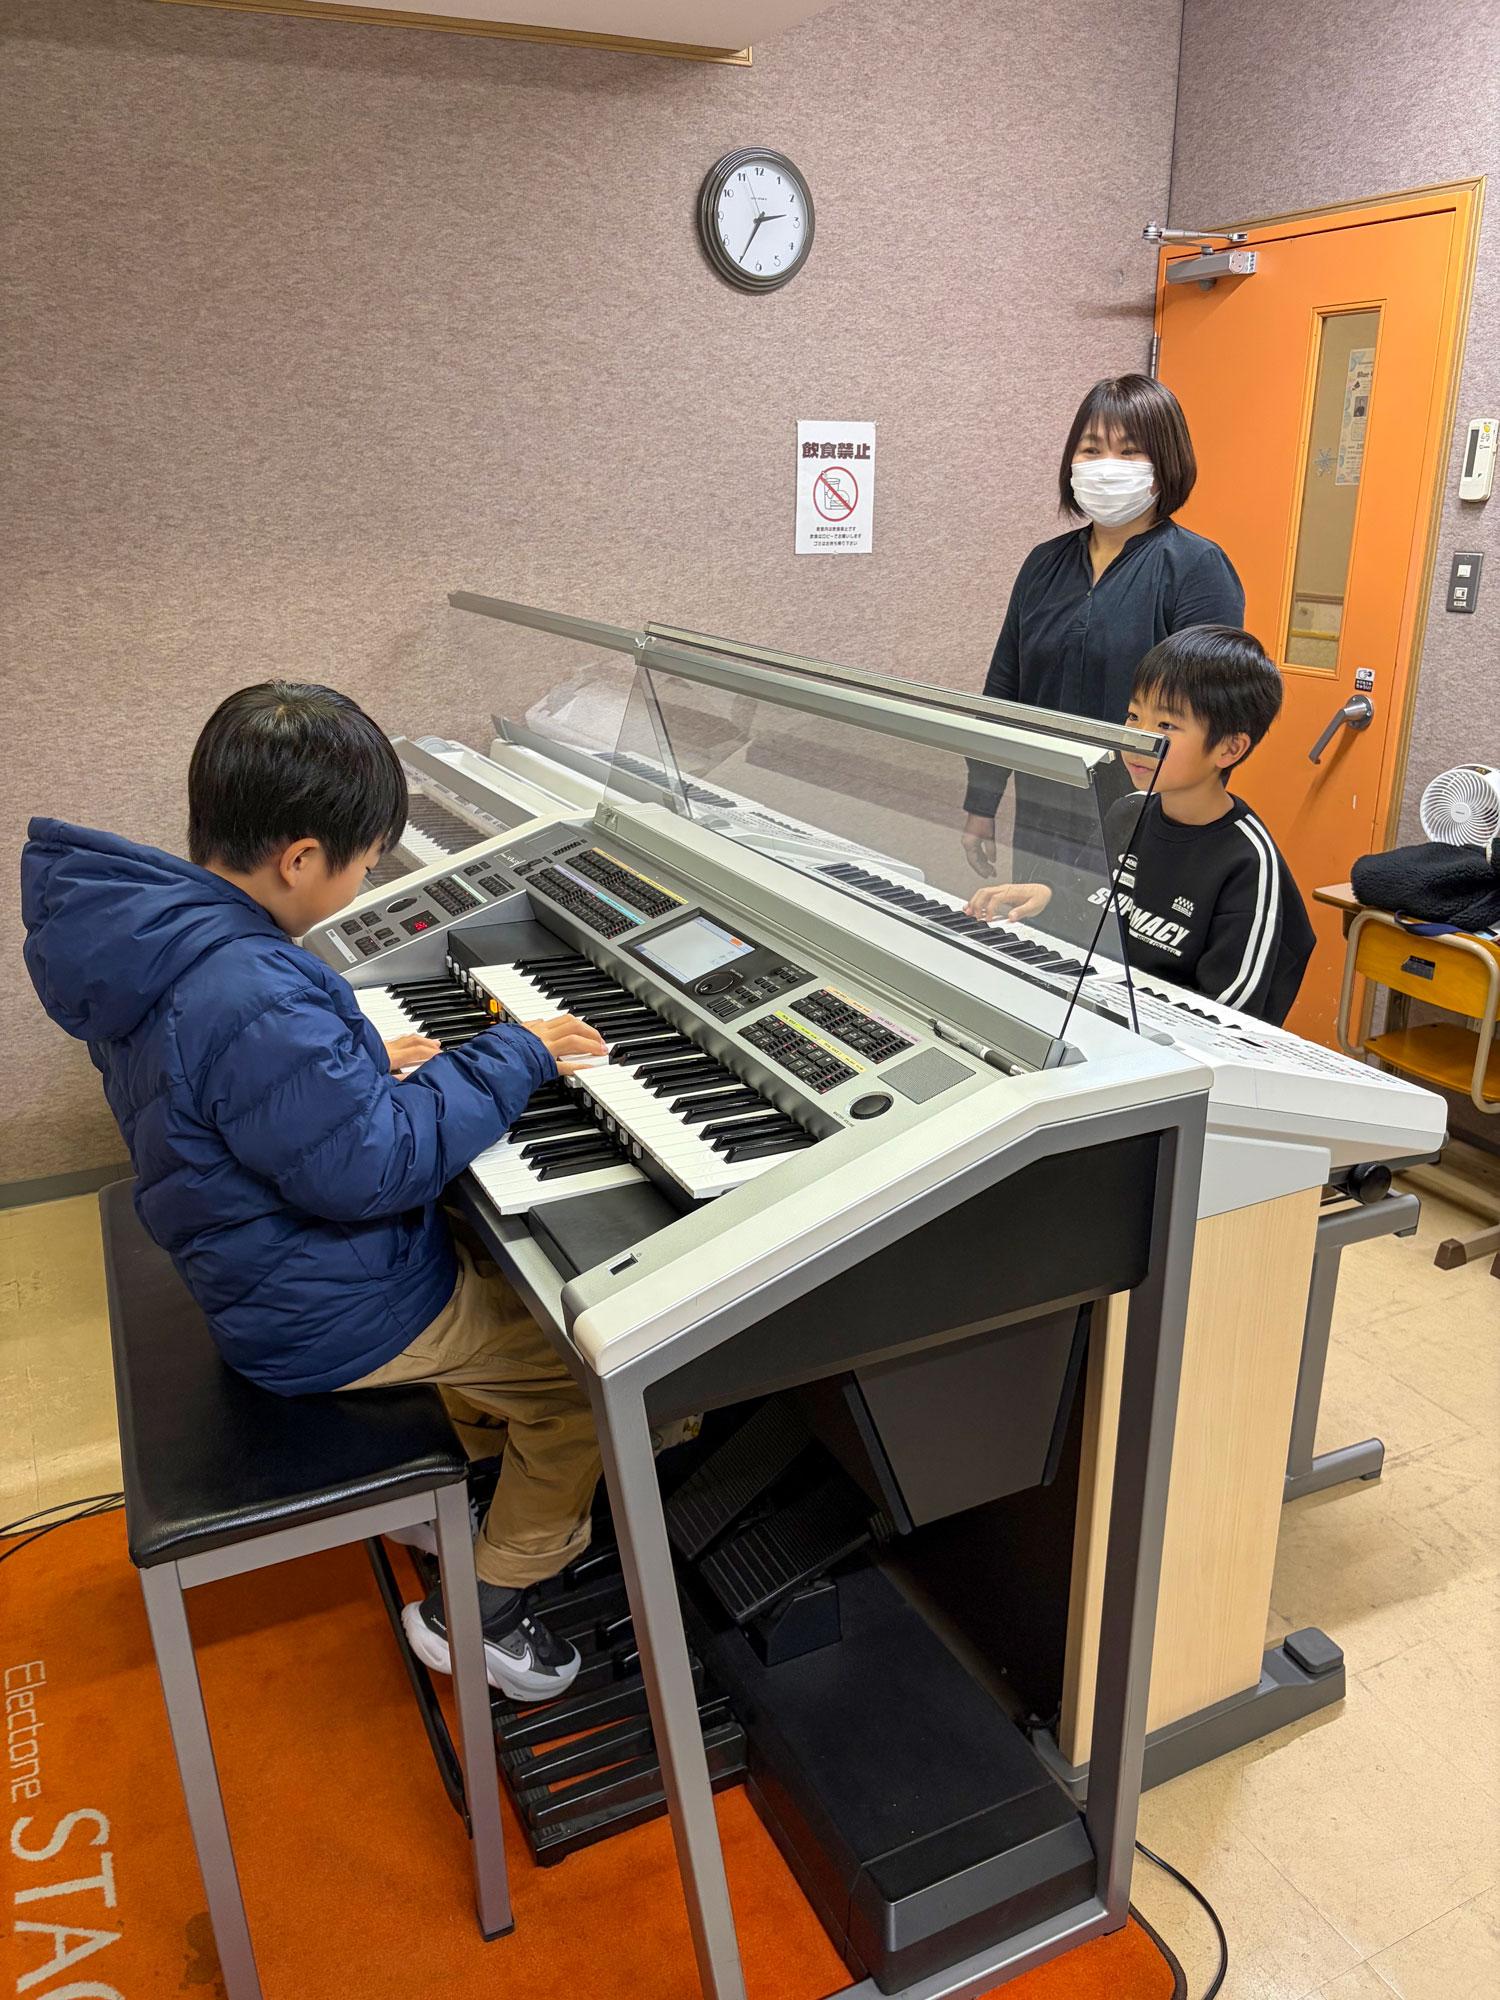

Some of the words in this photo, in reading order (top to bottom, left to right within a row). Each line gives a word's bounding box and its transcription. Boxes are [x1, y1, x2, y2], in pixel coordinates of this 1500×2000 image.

[755, 167, 765, 177] 12
[738, 173, 746, 182] 11
[777, 177, 781, 185] 1
[724, 189, 734, 198] 10
[790, 194, 795, 202] 2
[793, 217, 800, 229] 3
[774, 255, 782, 267] 5
[755, 262, 763, 272] 6
[802, 442, 870, 459] 飲食禁止
[4, 1659, 47, 1803] Electone
